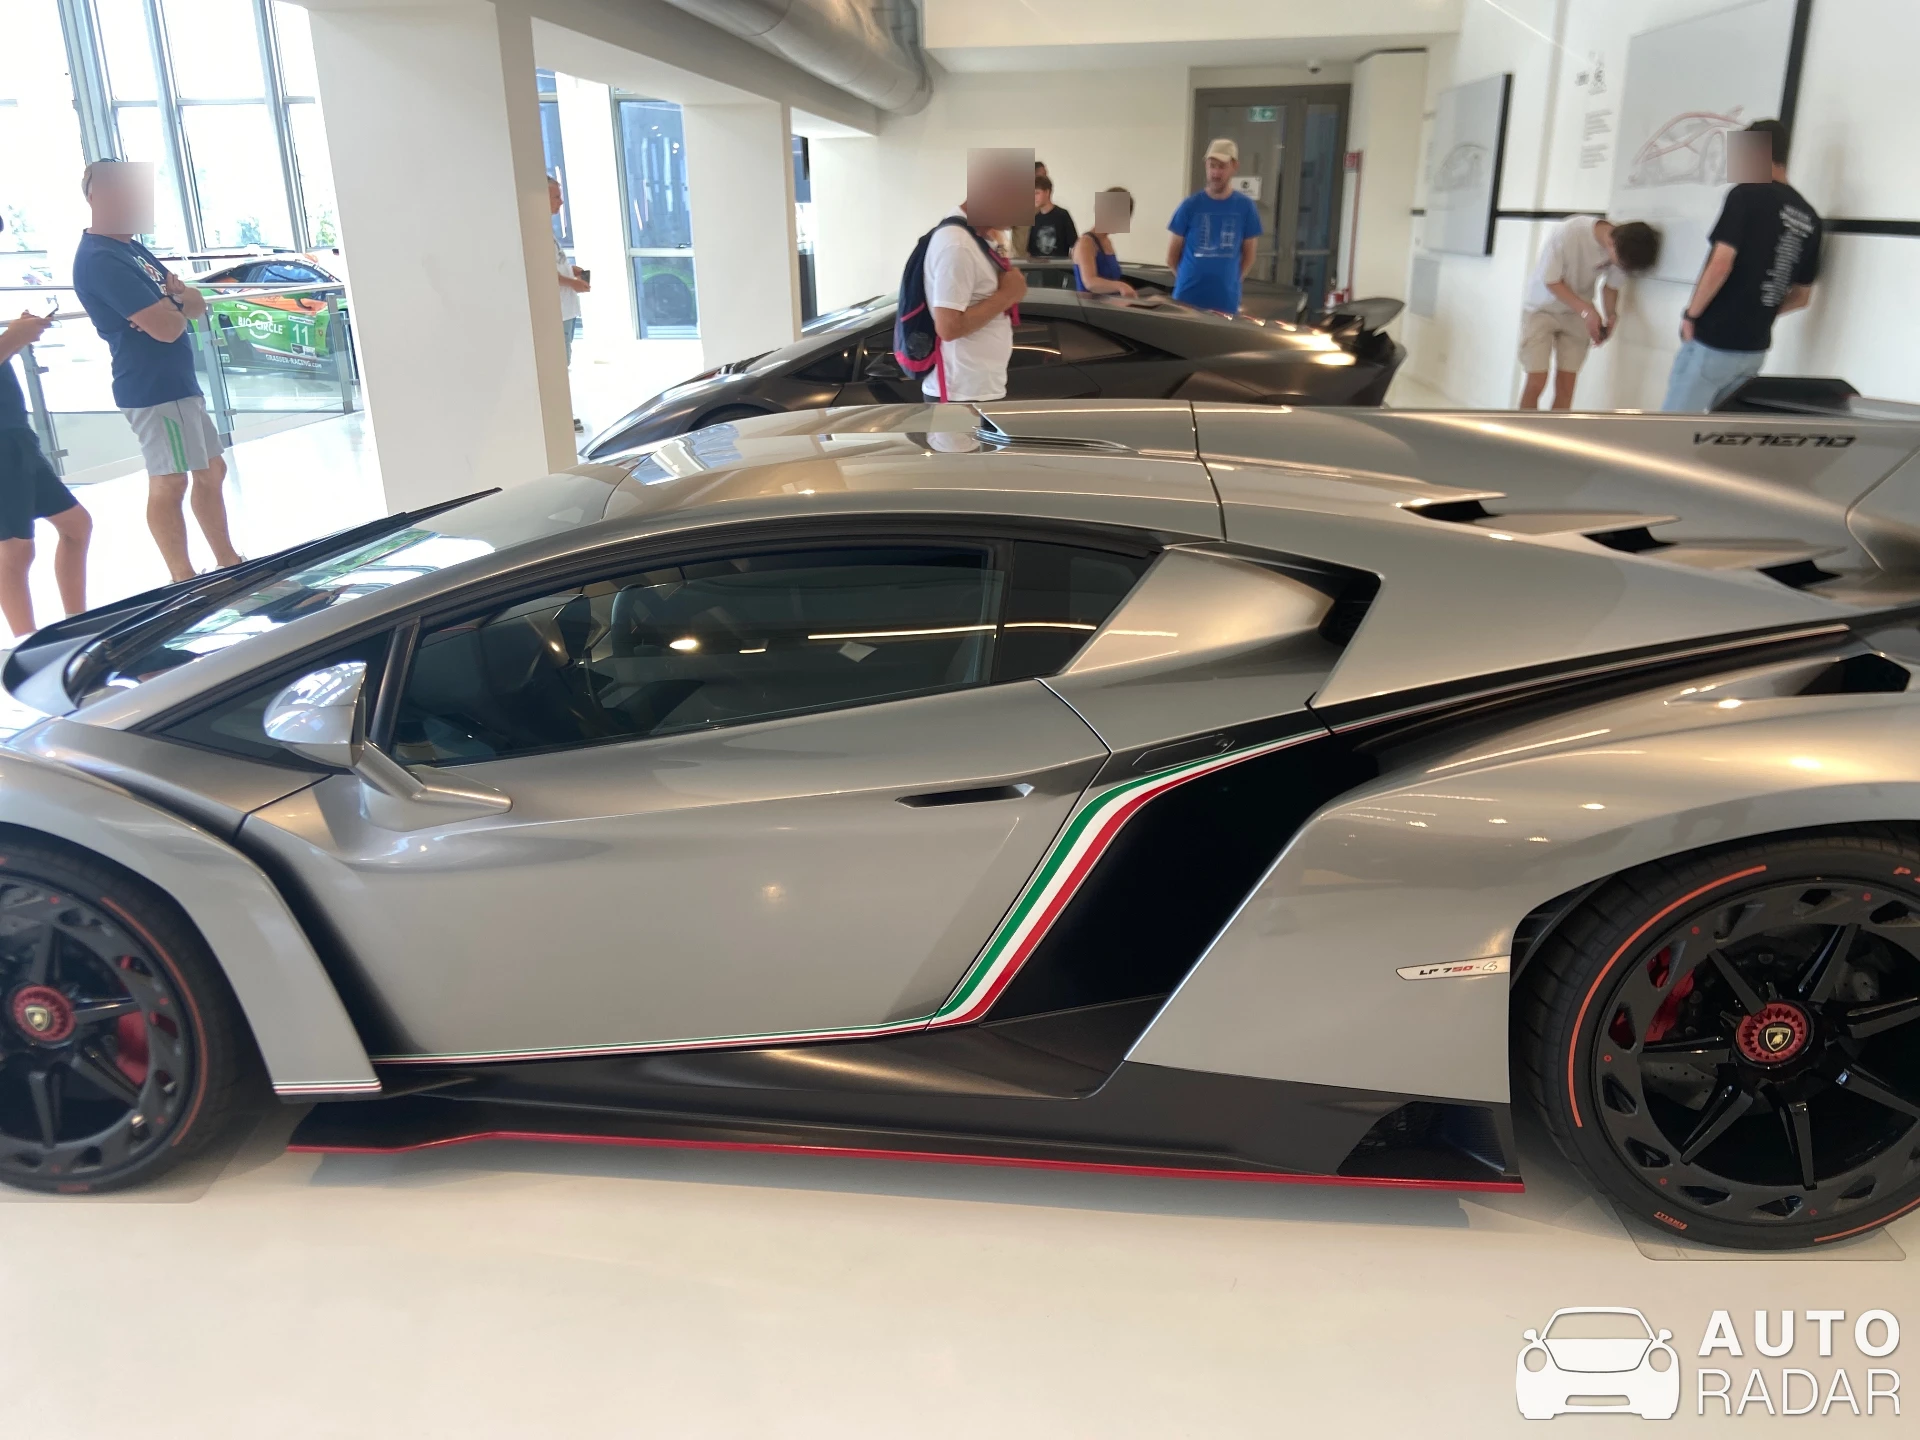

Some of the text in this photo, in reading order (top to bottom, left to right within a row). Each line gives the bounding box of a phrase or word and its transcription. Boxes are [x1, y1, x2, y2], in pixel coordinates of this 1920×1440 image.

[292, 323, 309, 345] 11
[1693, 432, 1857, 448] VENENO
[1419, 968, 1439, 976] LP
